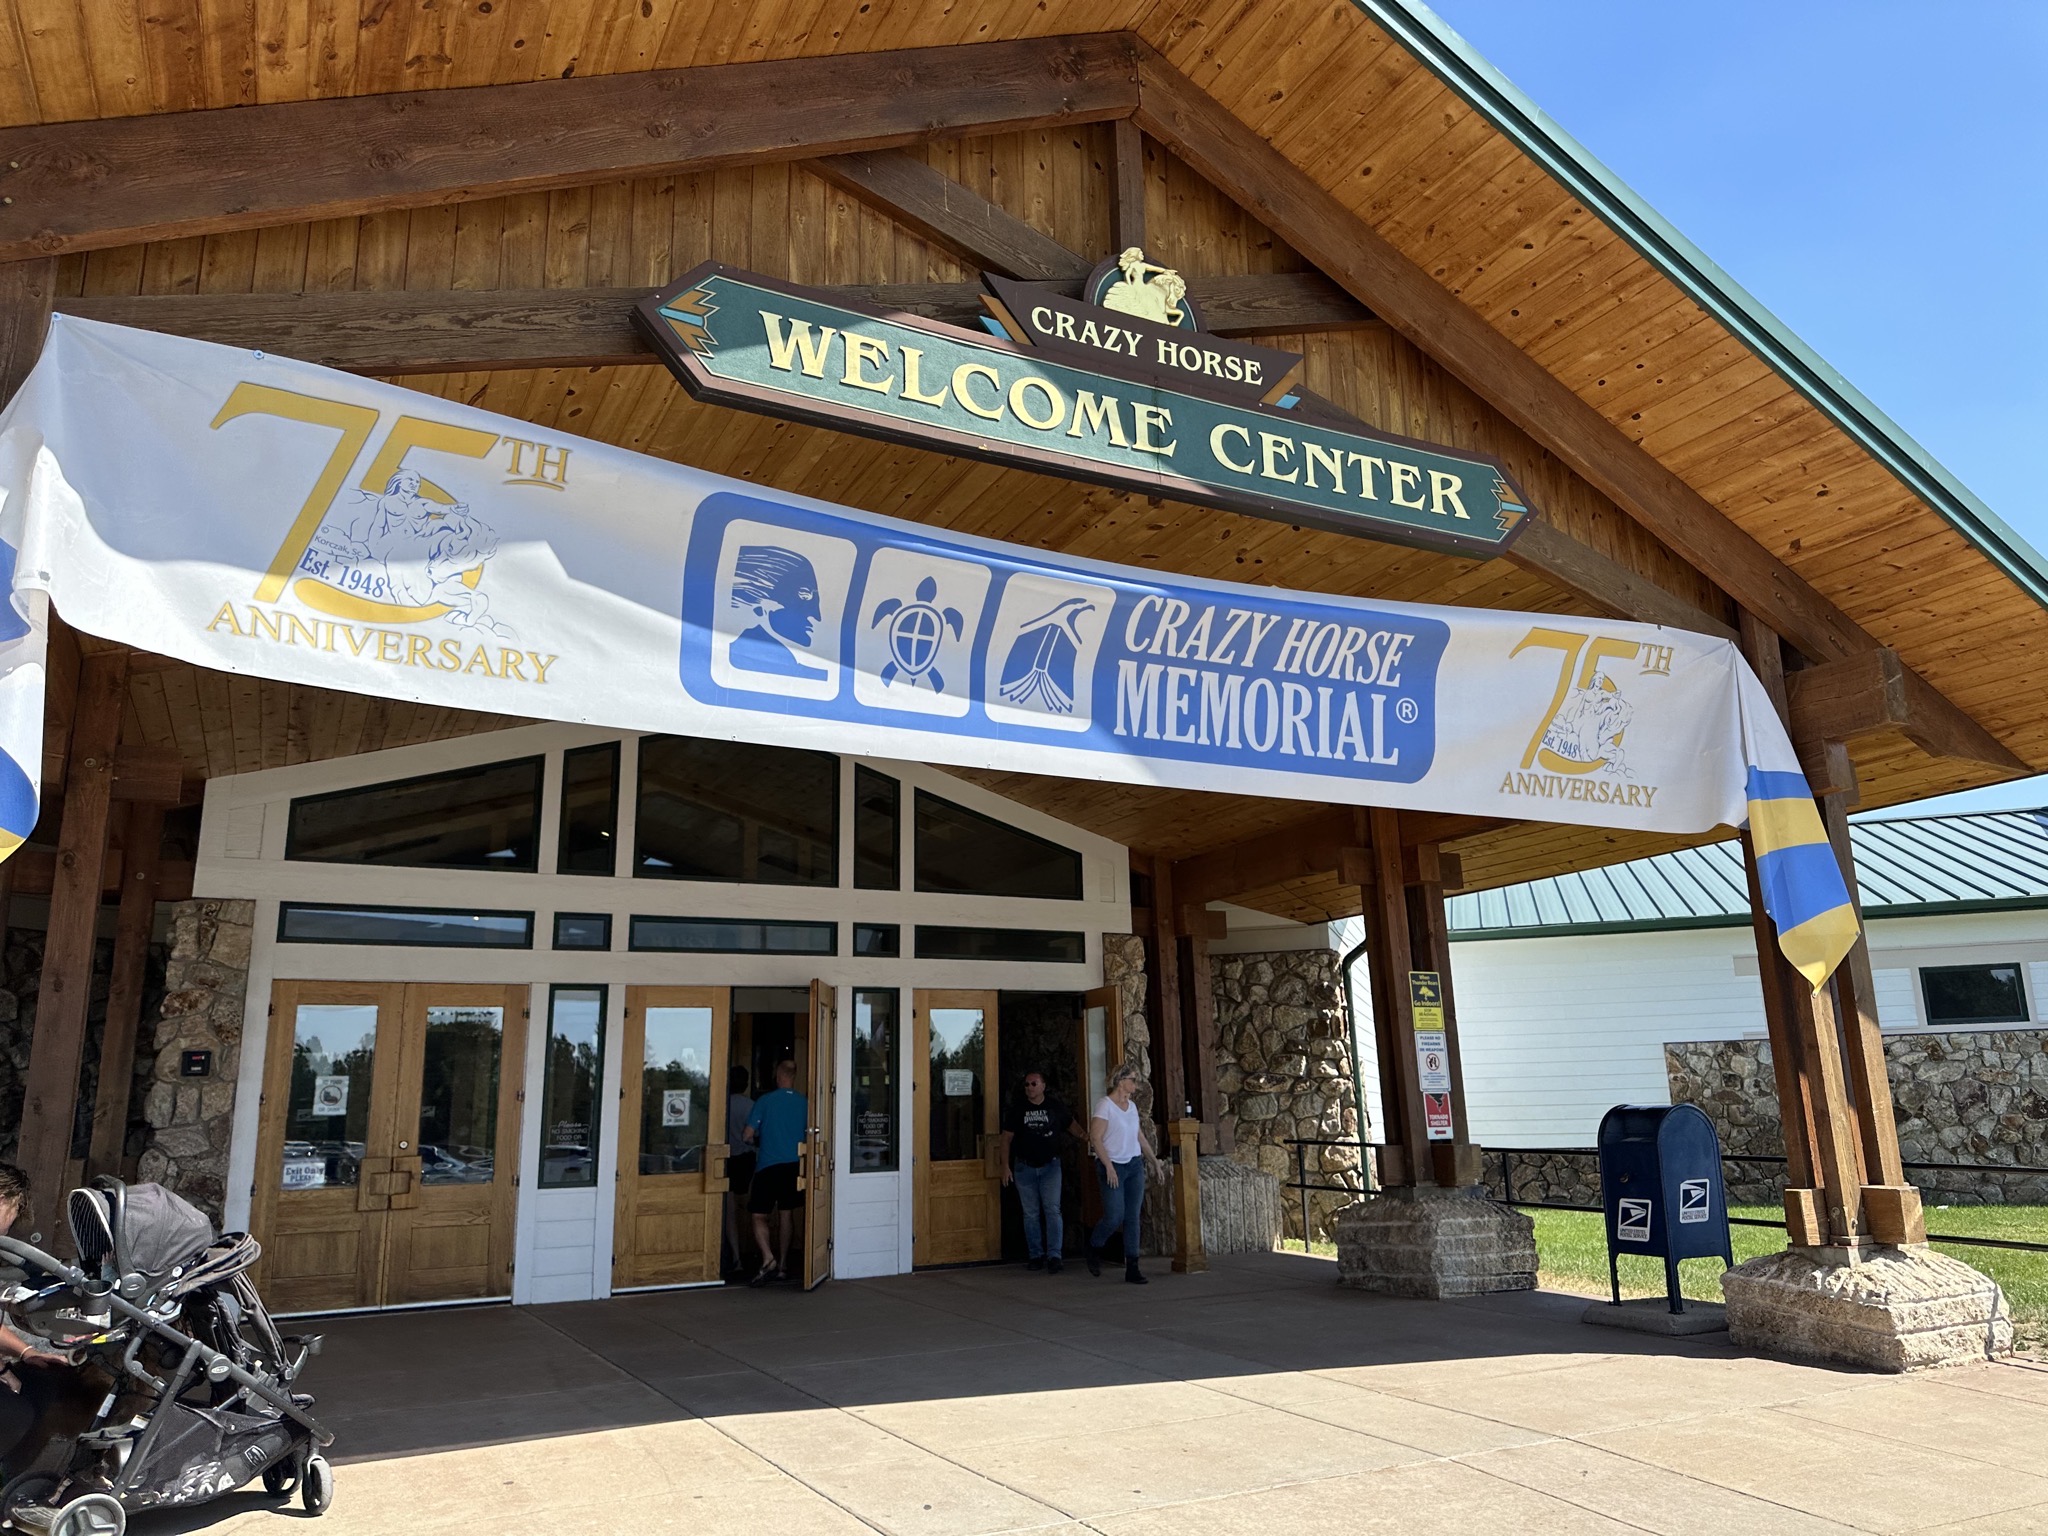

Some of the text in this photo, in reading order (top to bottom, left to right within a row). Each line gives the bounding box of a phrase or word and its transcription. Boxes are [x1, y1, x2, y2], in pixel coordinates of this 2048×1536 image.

[1031, 306, 1265, 387] CRAZY HORSE
[758, 309, 1471, 520] WELCOME CENTER
[299, 547, 386, 598] Est. 1948
[207, 601, 559, 685] ANNIVERSARY
[1125, 594, 1415, 688] CRAZY HORSE
[1557, 738, 1579, 759] 1948
[1499, 771, 1658, 809] ANNIVERSARY
[285, 1166, 325, 1176] Exit Only
